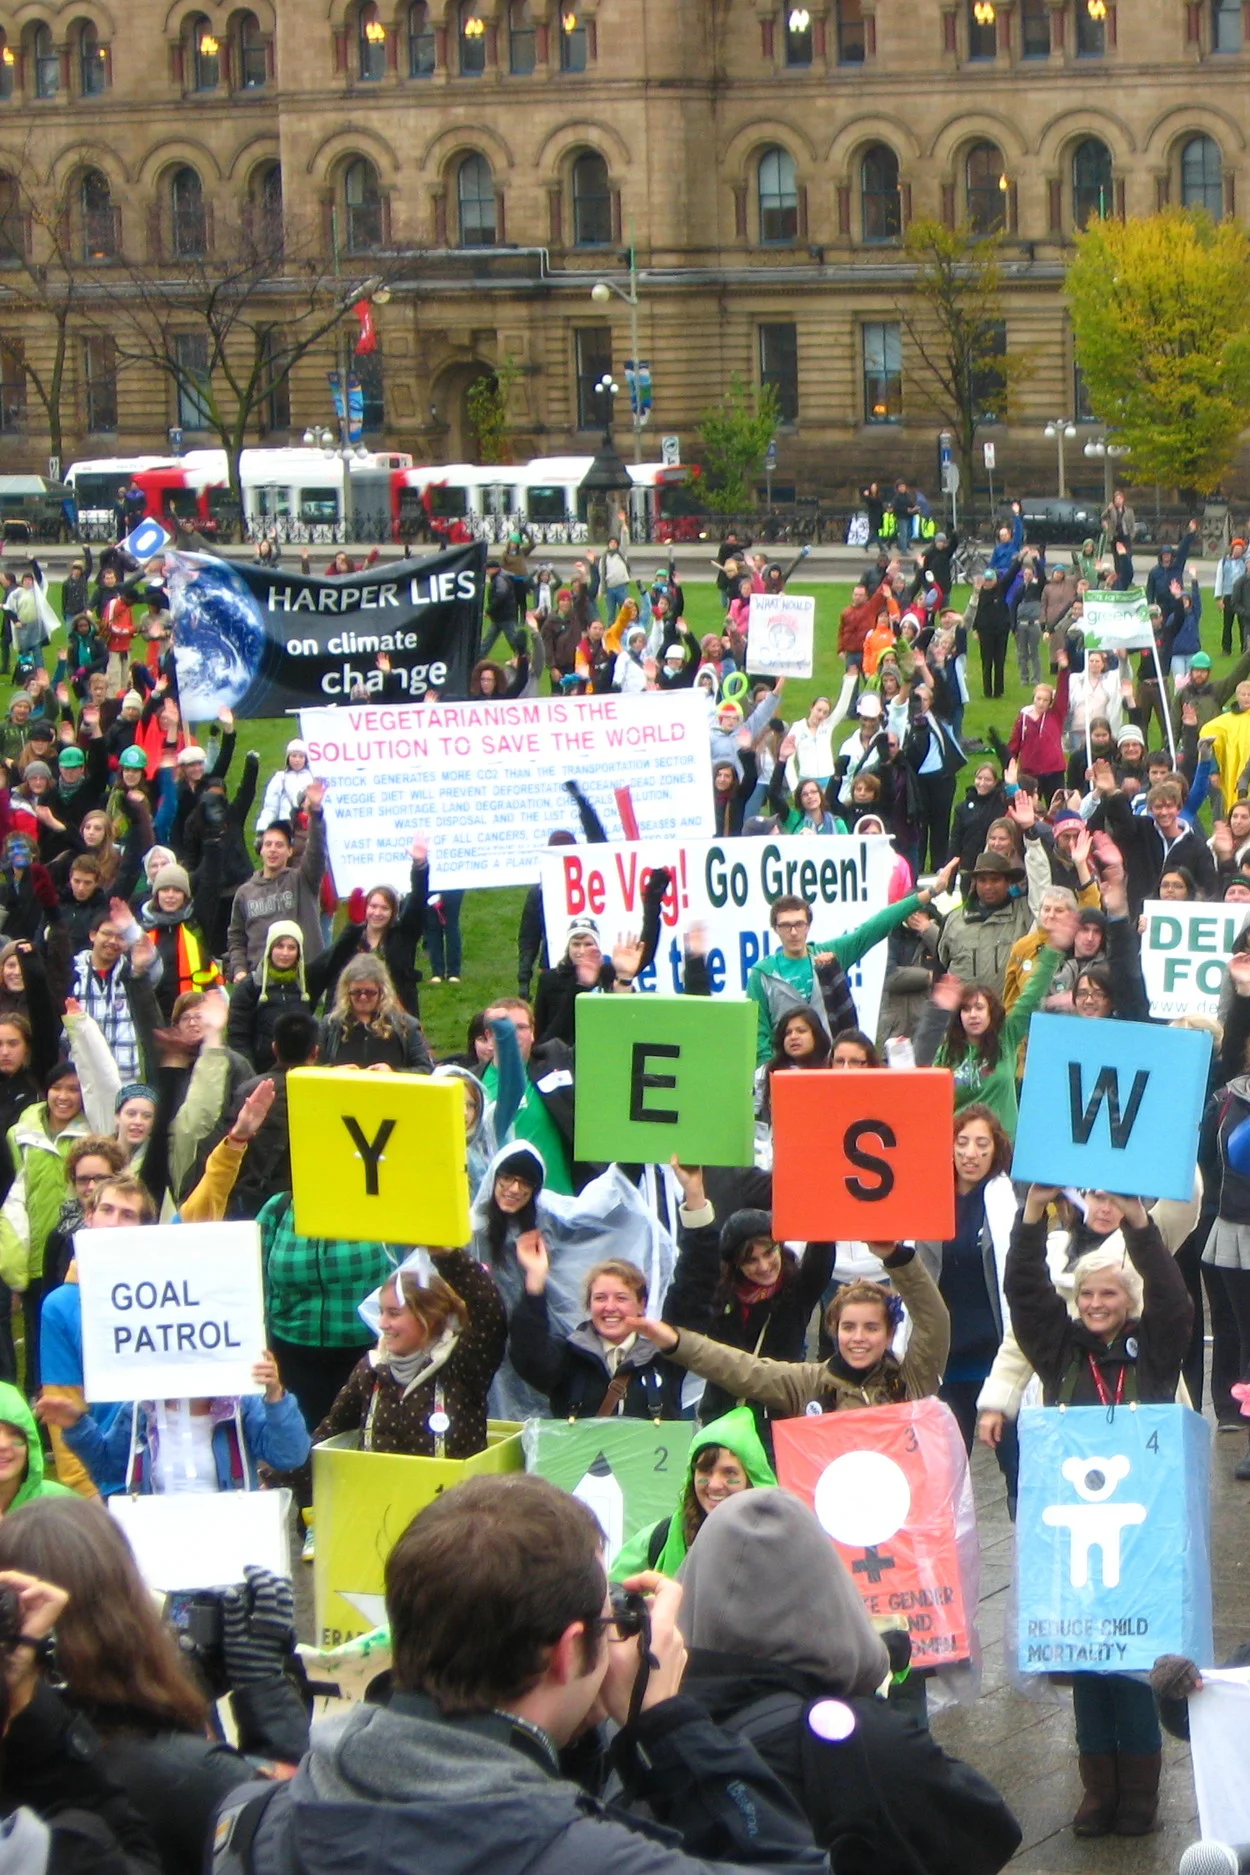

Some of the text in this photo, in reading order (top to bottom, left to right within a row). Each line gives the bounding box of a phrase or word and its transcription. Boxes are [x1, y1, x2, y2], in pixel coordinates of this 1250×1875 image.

[268, 570, 476, 612] HARPER LIES
[1087, 611, 1133, 625] green
[287, 630, 418, 656] on climate
[349, 701, 618, 731] VEGETARIANISM IS THE
[308, 722, 685, 762] SOLUTION TO SAVE THE WORLD
[373, 771, 436, 785] GENERATES
[441, 769, 472, 782] MORE
[477, 769, 498, 781] CO2
[504, 768, 531, 779] THAN
[537, 765, 555, 777] THE
[562, 758, 651, 775] TRANSPORTATION
[324, 794, 332, 804] A
[337, 792, 378, 804] VEGGIE
[381, 790, 405, 802] DIET
[410, 788, 434, 800] WILL
[439, 786, 487, 798] PREVENT
[335, 806, 373, 818] WATER
[442, 801, 470, 812] LAND
[394, 817, 431, 828] WASTE
[436, 815, 487, 827] DISPOSAL
[492, 812, 514, 823] AND
[520, 810, 540, 822] THE
[544, 810, 565, 821] LIST
[344, 838, 372, 850] VAST
[434, 835, 447, 845] OF
[453, 833, 472, 844] ALL
[680, 816, 702, 826] AND
[436, 859, 488, 872] ADOPTING
[493, 857, 500, 868] A
[563, 855, 605, 916] Be
[705, 845, 748, 908] Go
[761, 842, 868, 905] Green!
[669, 935, 726, 995] te
[629, 1042, 681, 1125] E
[1067, 1061, 1151, 1151] W
[341, 1115, 396, 1195] Y
[843, 1119, 898, 1201] S
[110, 1279, 200, 1311] GOAL
[113, 1320, 242, 1355] PATROL
[904, 1428, 920, 1453] 3
[1146, 1429, 1160, 1454] 4
[653, 1446, 669, 1472] 2
[888, 1587, 954, 1612] GENDER
[906, 1613, 933, 1633] ND
[1027, 1617, 1149, 1637] REDUCE CHILD
[1027, 1642, 1128, 1663] MORTALITY
